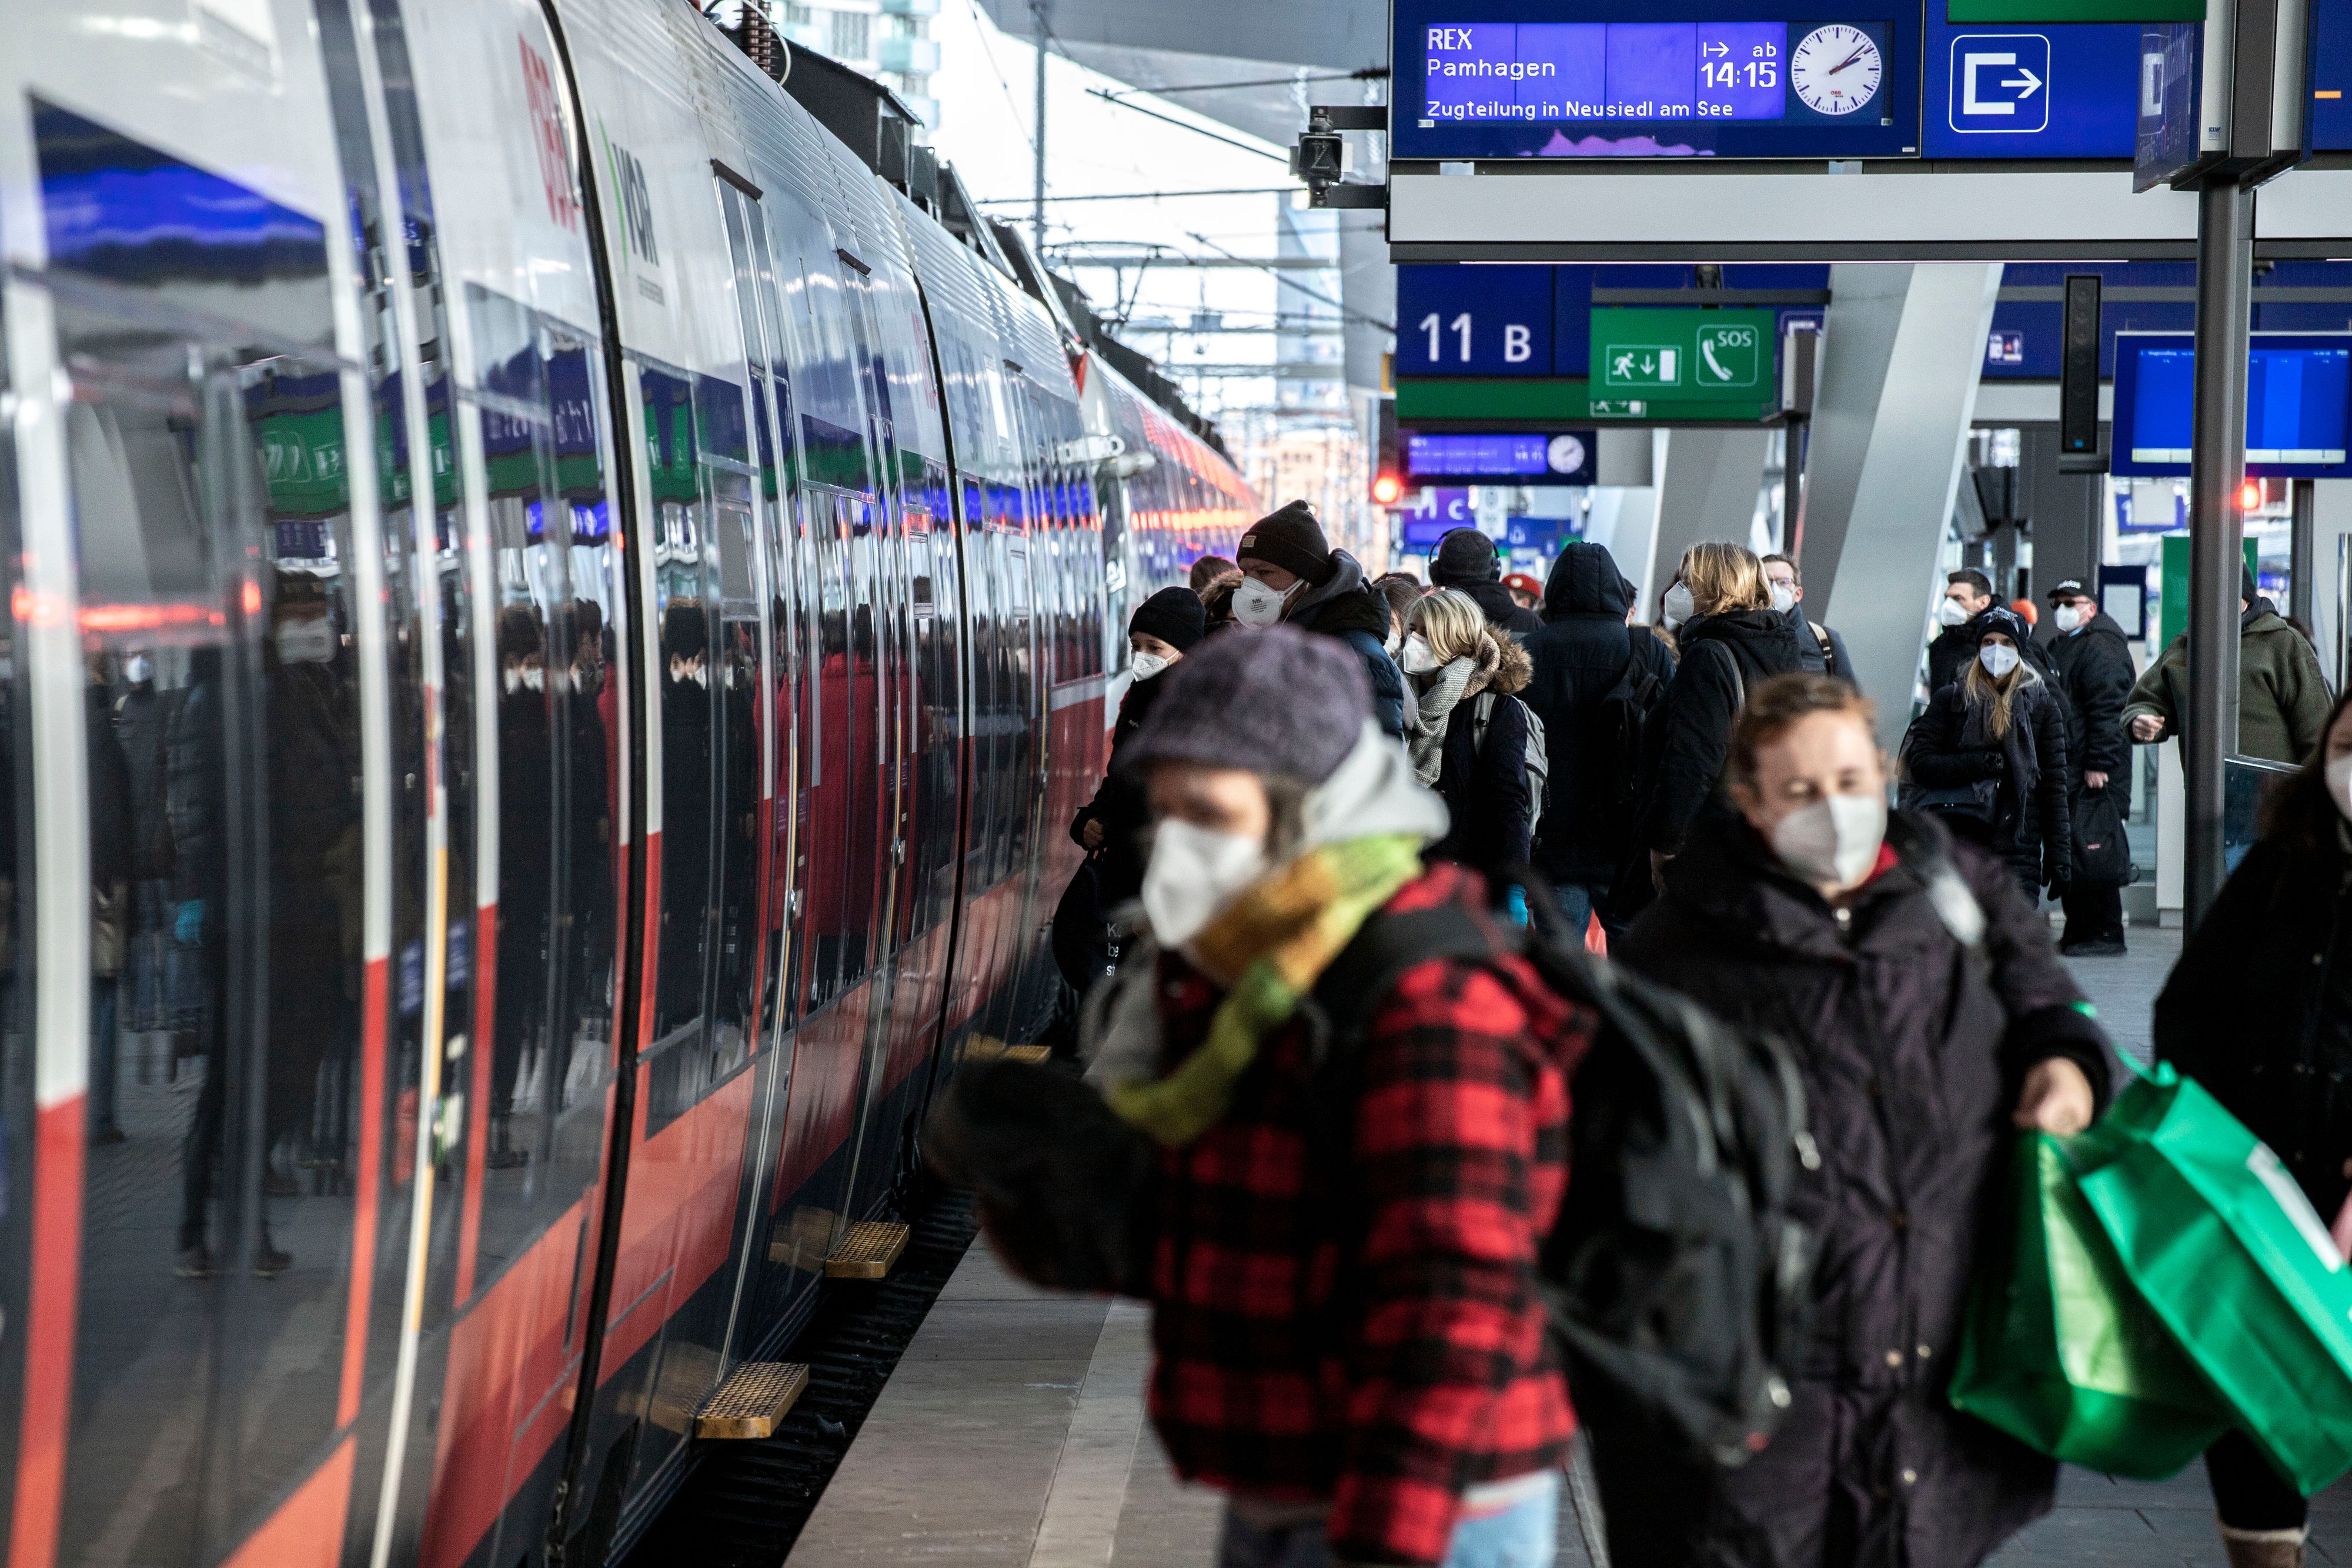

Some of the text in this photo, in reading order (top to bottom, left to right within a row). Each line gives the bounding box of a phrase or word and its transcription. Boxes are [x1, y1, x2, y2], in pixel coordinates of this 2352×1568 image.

[1428, 28, 1472, 50] REX
[1753, 41, 1776, 57] ab
[1427, 58, 1555, 81] Pamhagen
[1700, 61, 1776, 88] 14:15
[1427, 101, 1733, 121] Zugteilung in Neusiedl am See
[1419, 313, 1531, 362] 11 B
[1717, 330, 1752, 347] SOS
